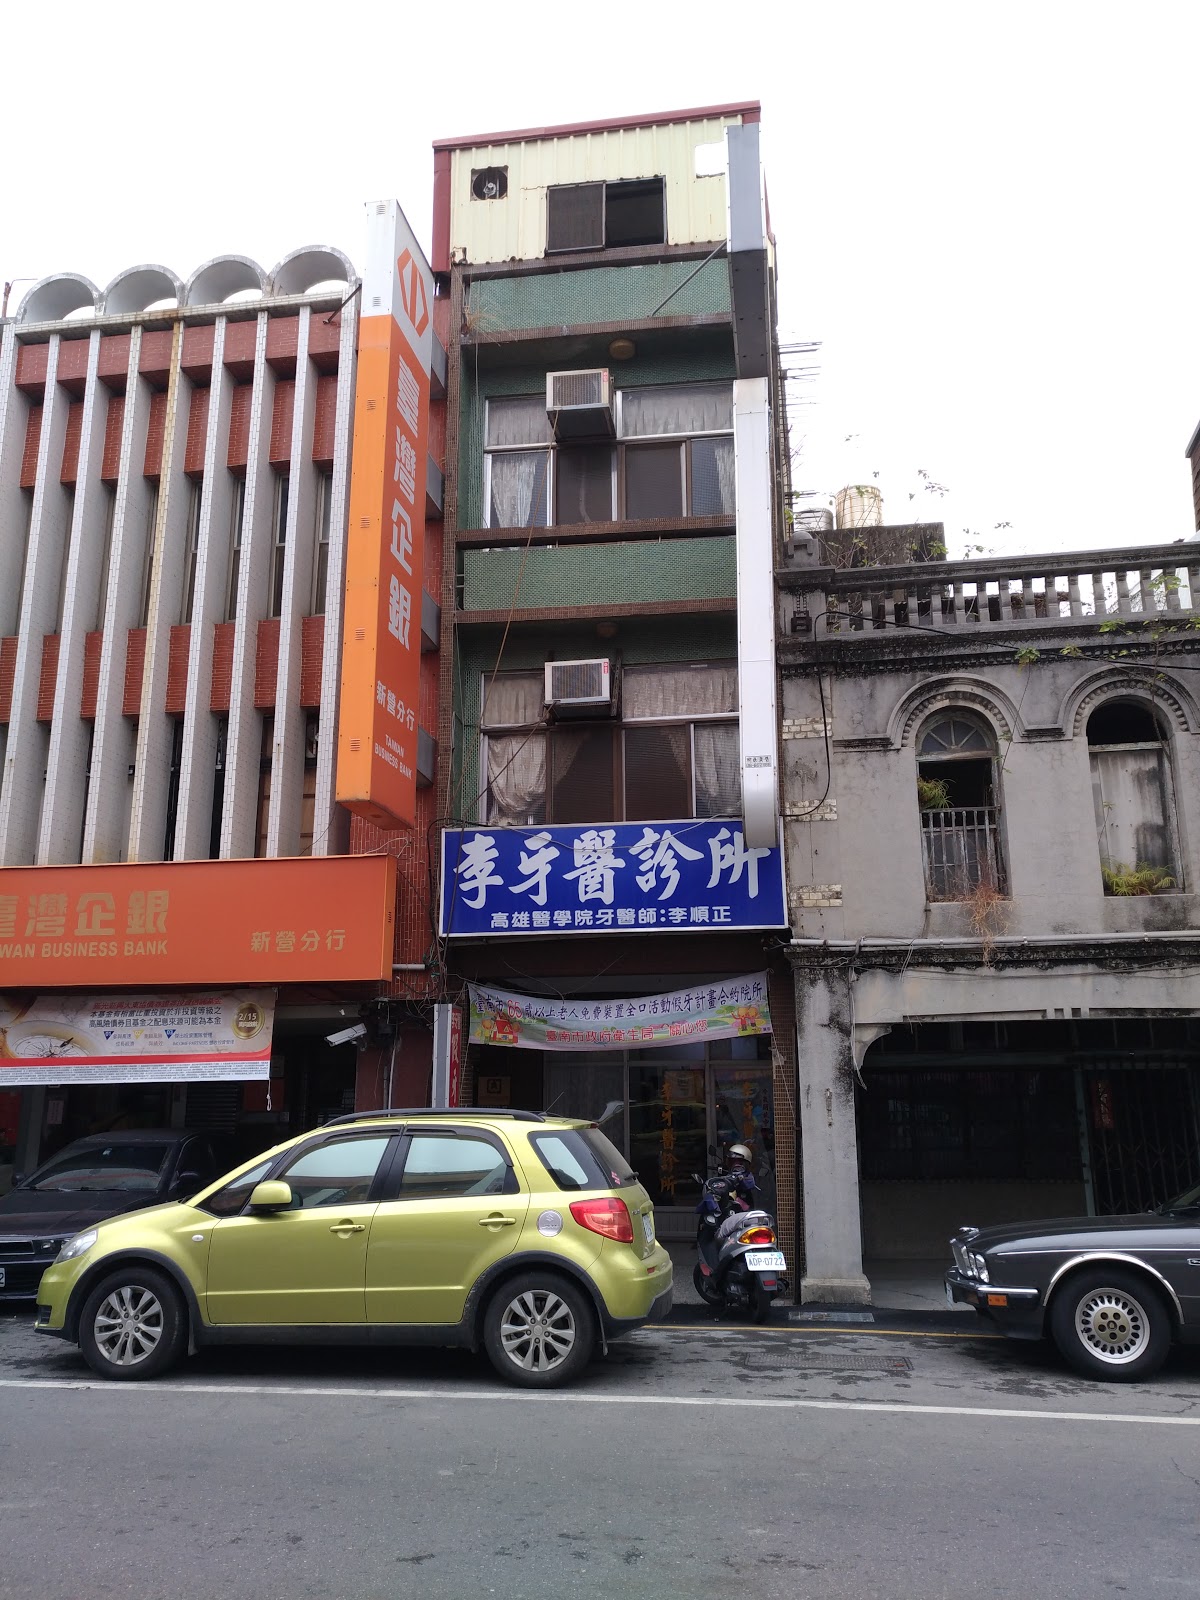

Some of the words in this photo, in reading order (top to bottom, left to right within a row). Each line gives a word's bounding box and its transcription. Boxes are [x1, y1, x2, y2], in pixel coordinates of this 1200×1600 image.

[387, 352, 419, 651] 臺灣企銀
[377, 680, 415, 731] 新營分行
[386, 734, 404, 758] TAIWAN
[375, 743, 398, 769] BUSINESS
[400, 761, 412, 779] BANK
[453, 826, 772, 909] 李牙醫診所
[490, 905, 732, 929] 高雄醫學院牙醫師:李順正
[41, 941, 118, 958] BUSINESS
[124, 940, 168, 956] BANK
[251, 929, 346, 953] 新營分行
[238, 1012, 257, 1021] 2/15
[546, 1027, 654, 1043] 臺南市政府衛生局
[669, 1020, 708, 1037] 關心您
[748, 1257, 785, 1266] ADP-0722
